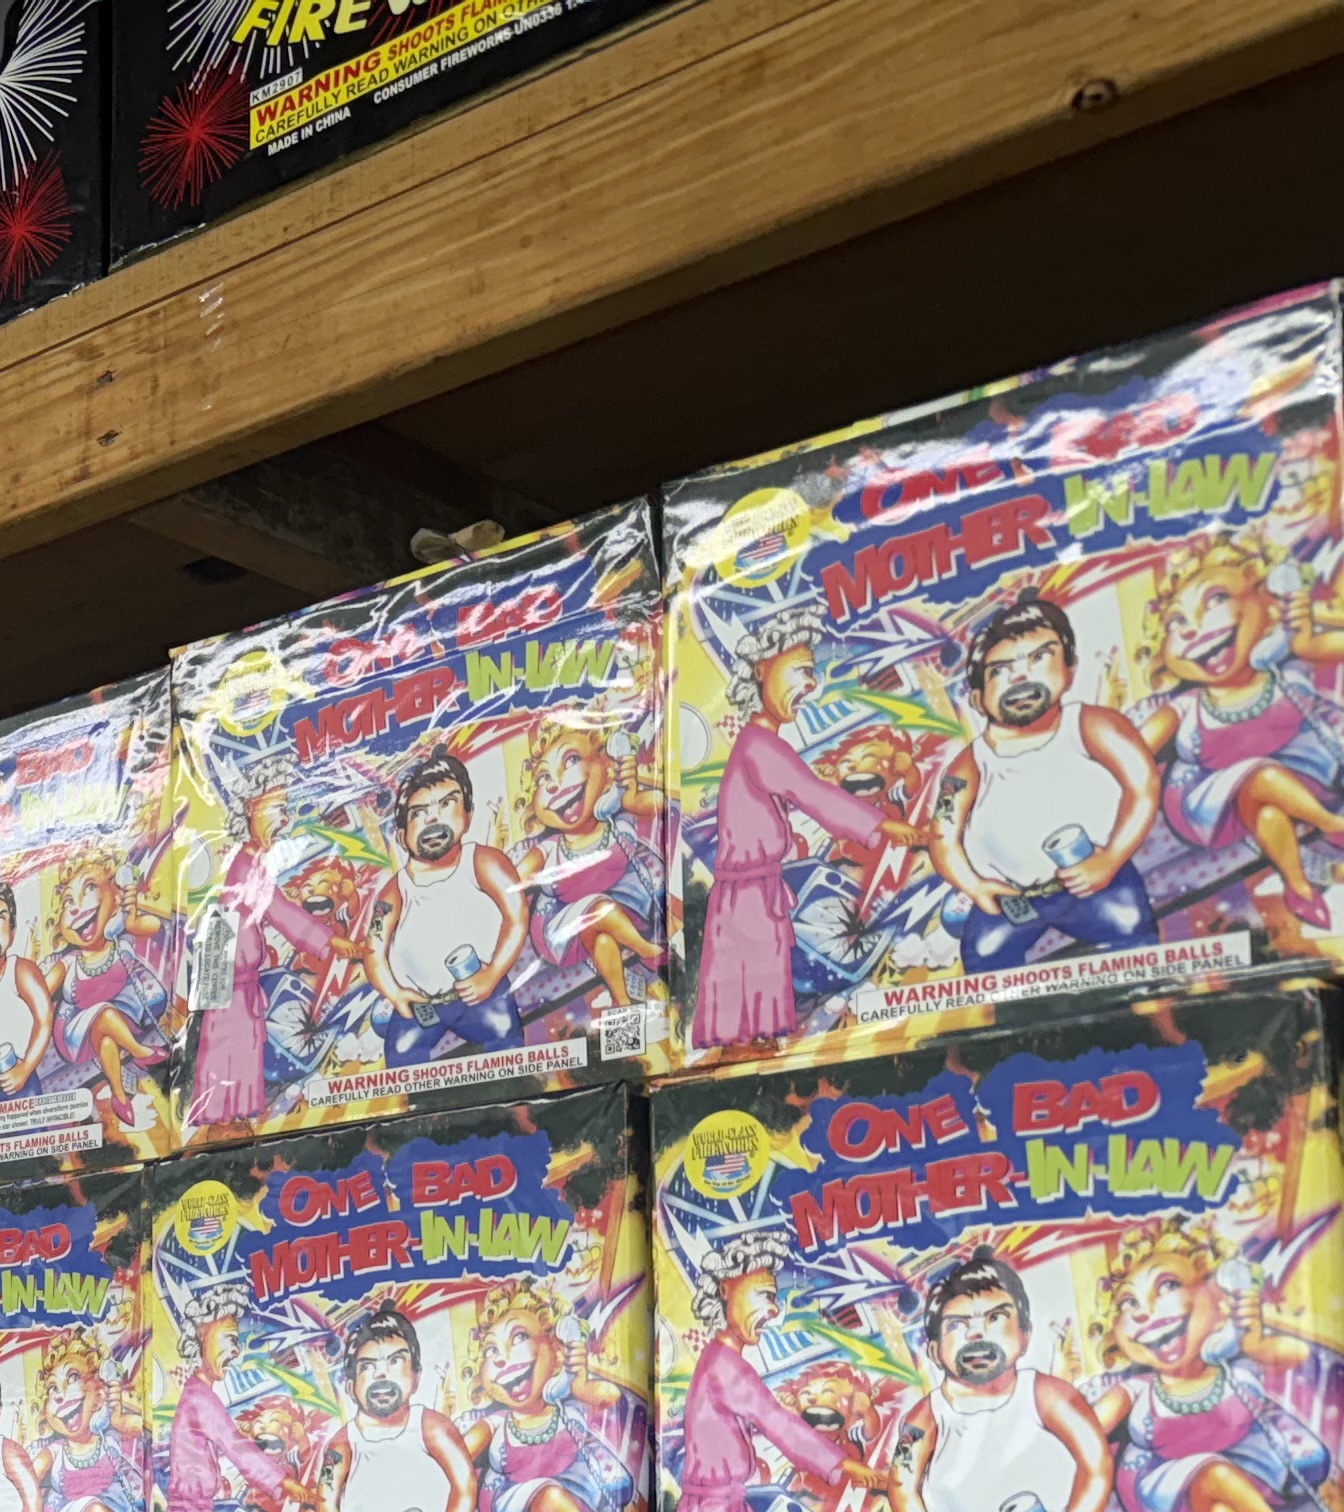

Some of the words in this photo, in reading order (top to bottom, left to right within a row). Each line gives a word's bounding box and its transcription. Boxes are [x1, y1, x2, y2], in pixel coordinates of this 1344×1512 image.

[255, 92, 343, 144] CAREFULLY
[346, 67, 390, 100] READ
[393, 27, 470, 75] WARNING
[474, 12, 499, 36] ON
[256, 50, 381, 127] WARNING
[387, 14, 456, 63] SHOOTS
[267, 133, 299, 156] MADE
[300, 125, 313, 142] IN
[315, 105, 352, 133] CHINA
[372, 64, 439, 105] CONSUMER
[861, 448, 1006, 526] ONE
[311, 1089, 370, 1107] CAREFULLY
[372, 1084, 402, 1098] READ
[404, 1078, 442, 1093] OTHER
[443, 1071, 496, 1088] WARNING
[498, 1067, 515, 1080] ON
[518, 1062, 544, 1076] SIDE
[546, 1056, 584, 1071] PANEL
[327, 1069, 410, 1094] WARNING
[412, 1063, 464, 1080] SHOOTS
[467, 1055, 524, 1075] FLAMING
[527, 1046, 570, 1063] BALLS
[826, 1093, 973, 1162] ONE
[1013, 1071, 1161, 1137] BAD
[278, 1168, 380, 1223] ONE
[411, 1154, 518, 1208] BAD
